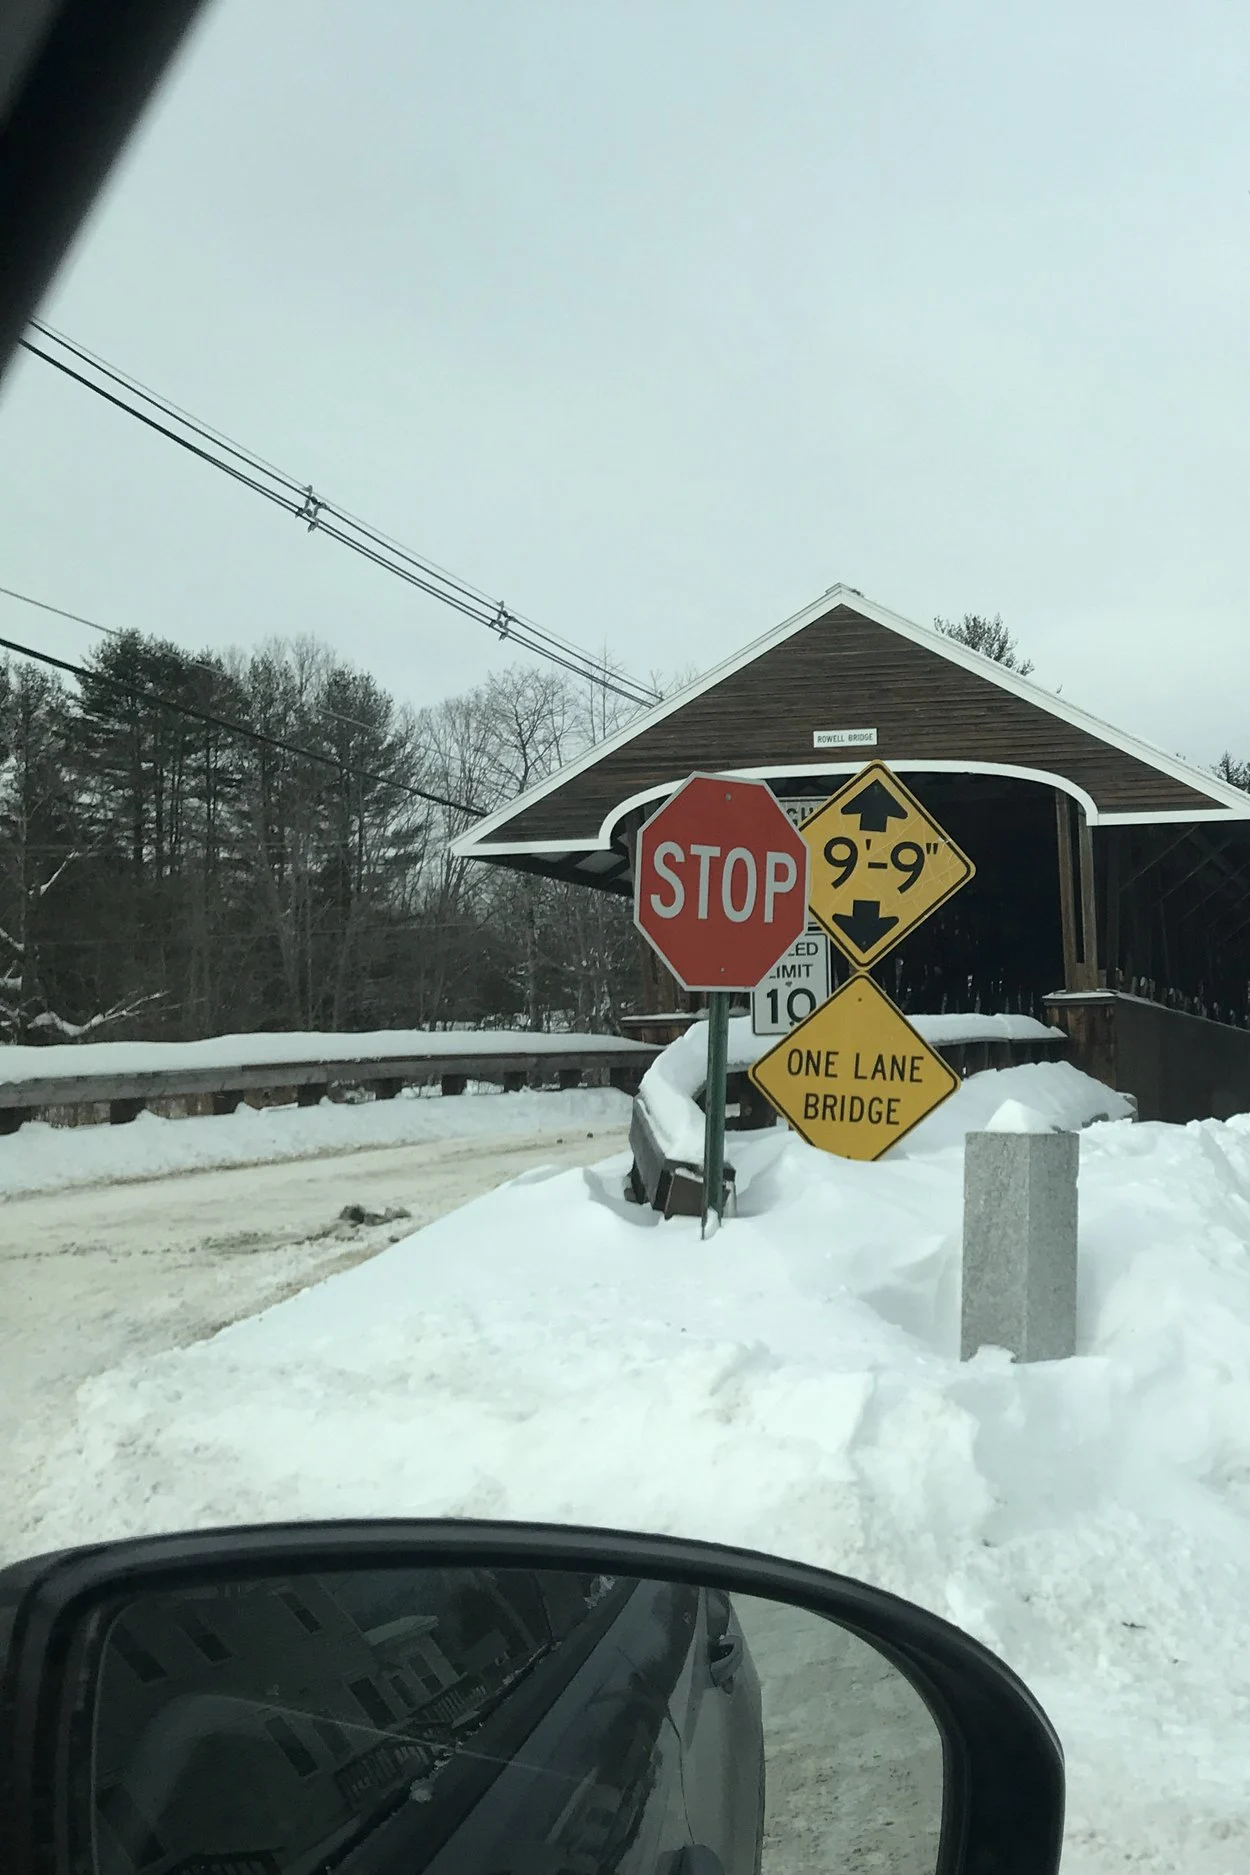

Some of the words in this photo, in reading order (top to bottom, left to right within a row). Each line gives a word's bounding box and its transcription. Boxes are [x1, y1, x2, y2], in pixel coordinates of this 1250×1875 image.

[817, 734, 845, 743] ROWELL
[848, 732, 873, 742] BRIDGE
[650, 841, 797, 923] STOP
[766, 987, 817, 1025] 10
[787, 1048, 839, 1078] ONE
[854, 1052, 924, 1083] LANE
[804, 1092, 901, 1125] BRIDGE
